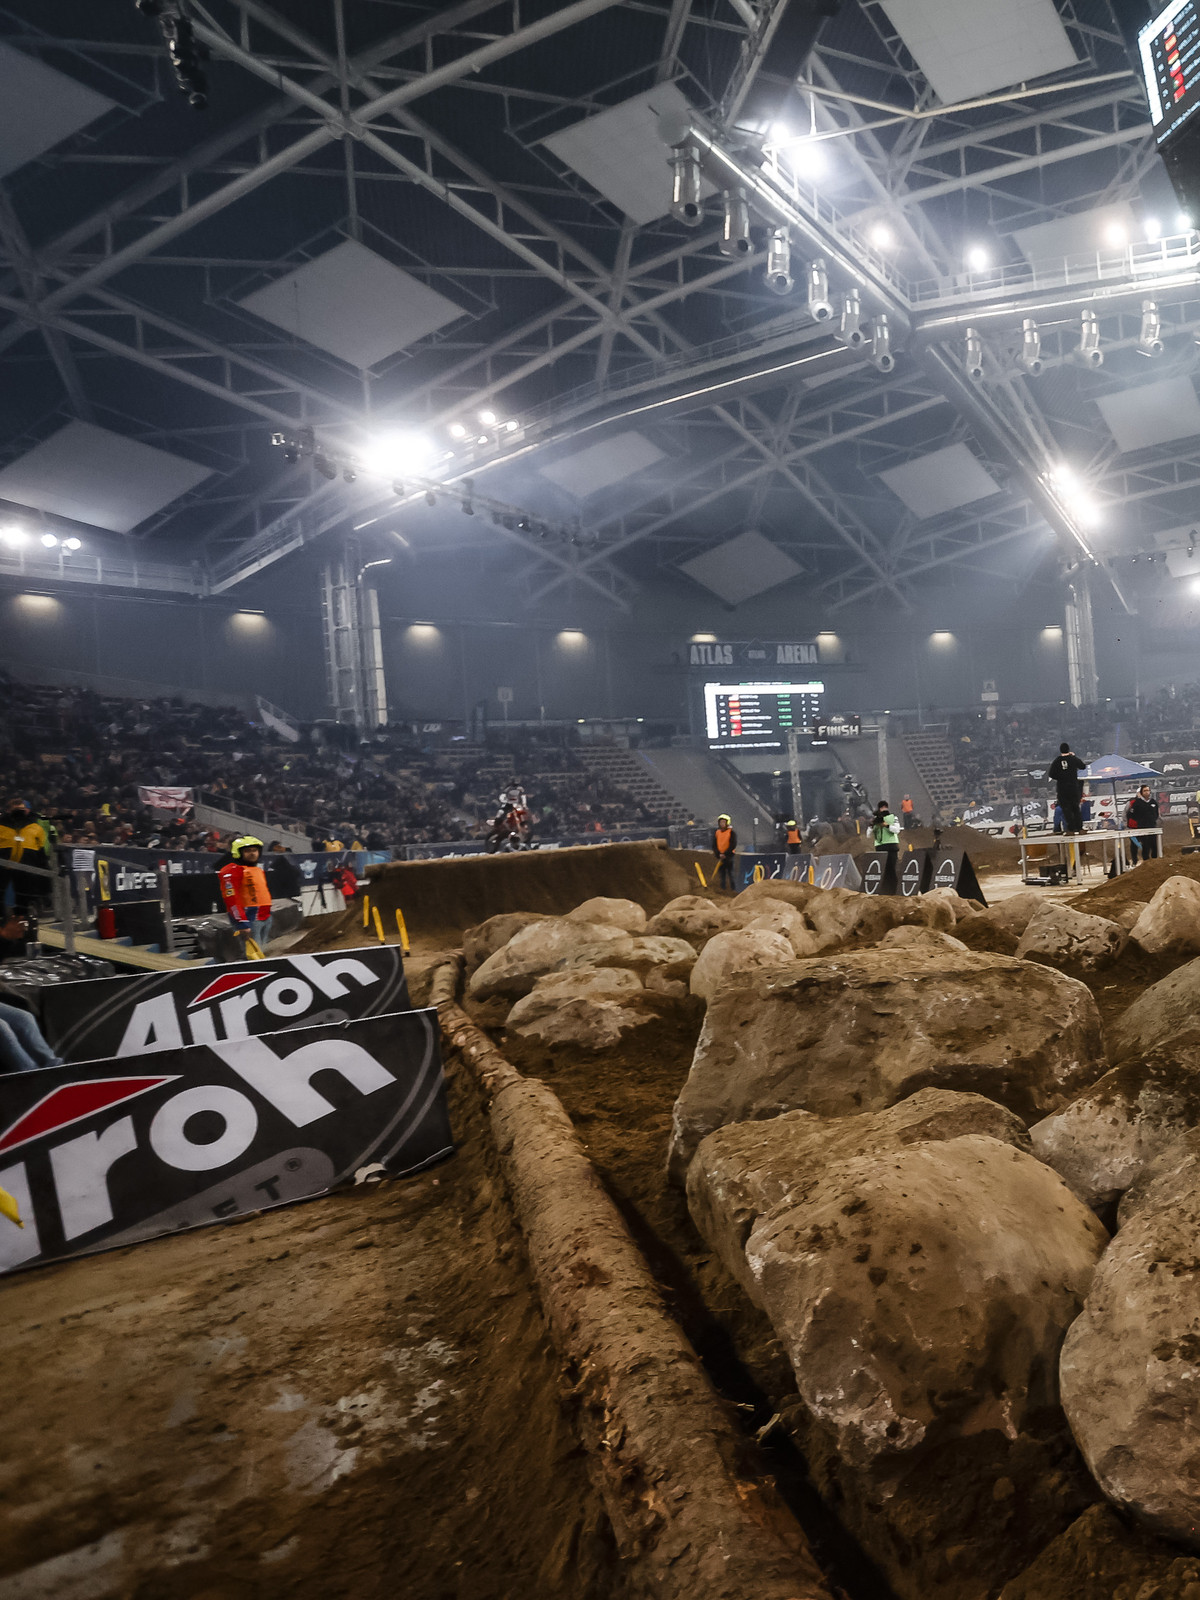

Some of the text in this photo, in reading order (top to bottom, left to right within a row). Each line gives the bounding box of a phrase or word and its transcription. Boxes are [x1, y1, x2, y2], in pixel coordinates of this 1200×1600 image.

[690, 645, 734, 665] ATLAS
[776, 645, 818, 664] ARENA
[818, 726, 860, 736] FINISH
[963, 806, 994, 821] Airoh
[1010, 802, 1042, 817] Aroh
[117, 955, 380, 1057] Airoh
